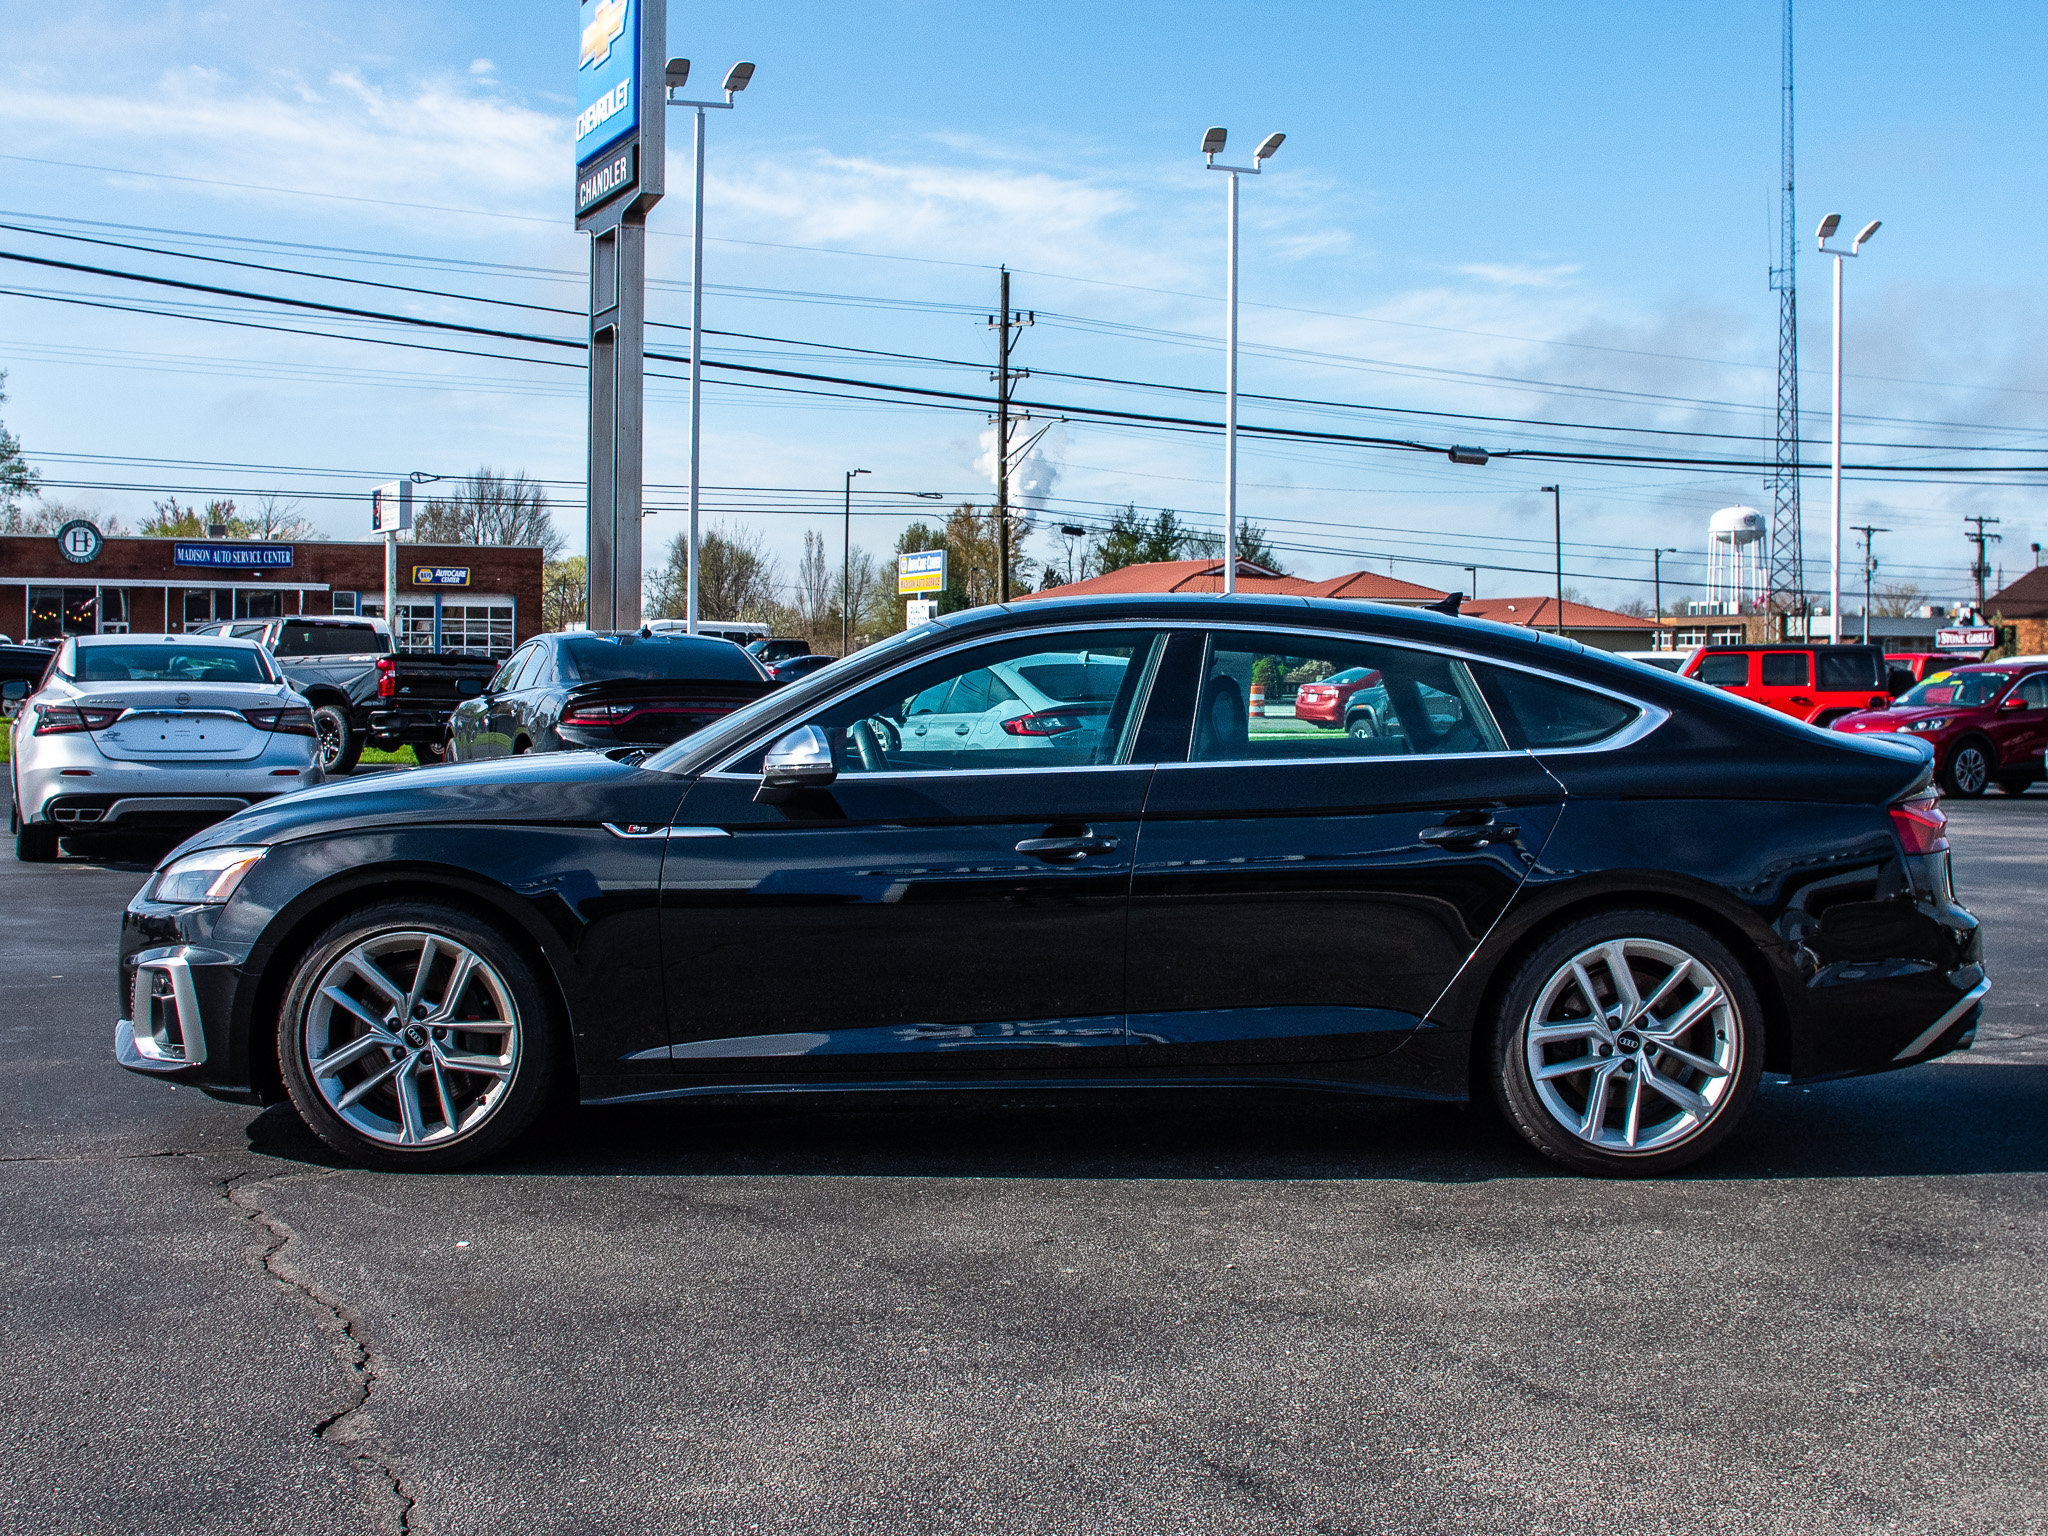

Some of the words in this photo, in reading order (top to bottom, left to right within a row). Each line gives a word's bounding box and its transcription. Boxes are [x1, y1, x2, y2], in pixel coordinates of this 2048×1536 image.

[576, 77, 631, 143] CHEVROLET
[579, 156, 627, 208] CHANDLER
[177, 548, 211, 562] MADISON
[212, 550, 232, 564] AUTO
[232, 550, 261, 564] SERVICE
[263, 550, 291, 564] CENTER
[916, 578, 925, 587] AUTO
[926, 577, 940, 587] SERVICE
[1940, 632, 1965, 645] STONE
[1966, 631, 1989, 645] GRILL
